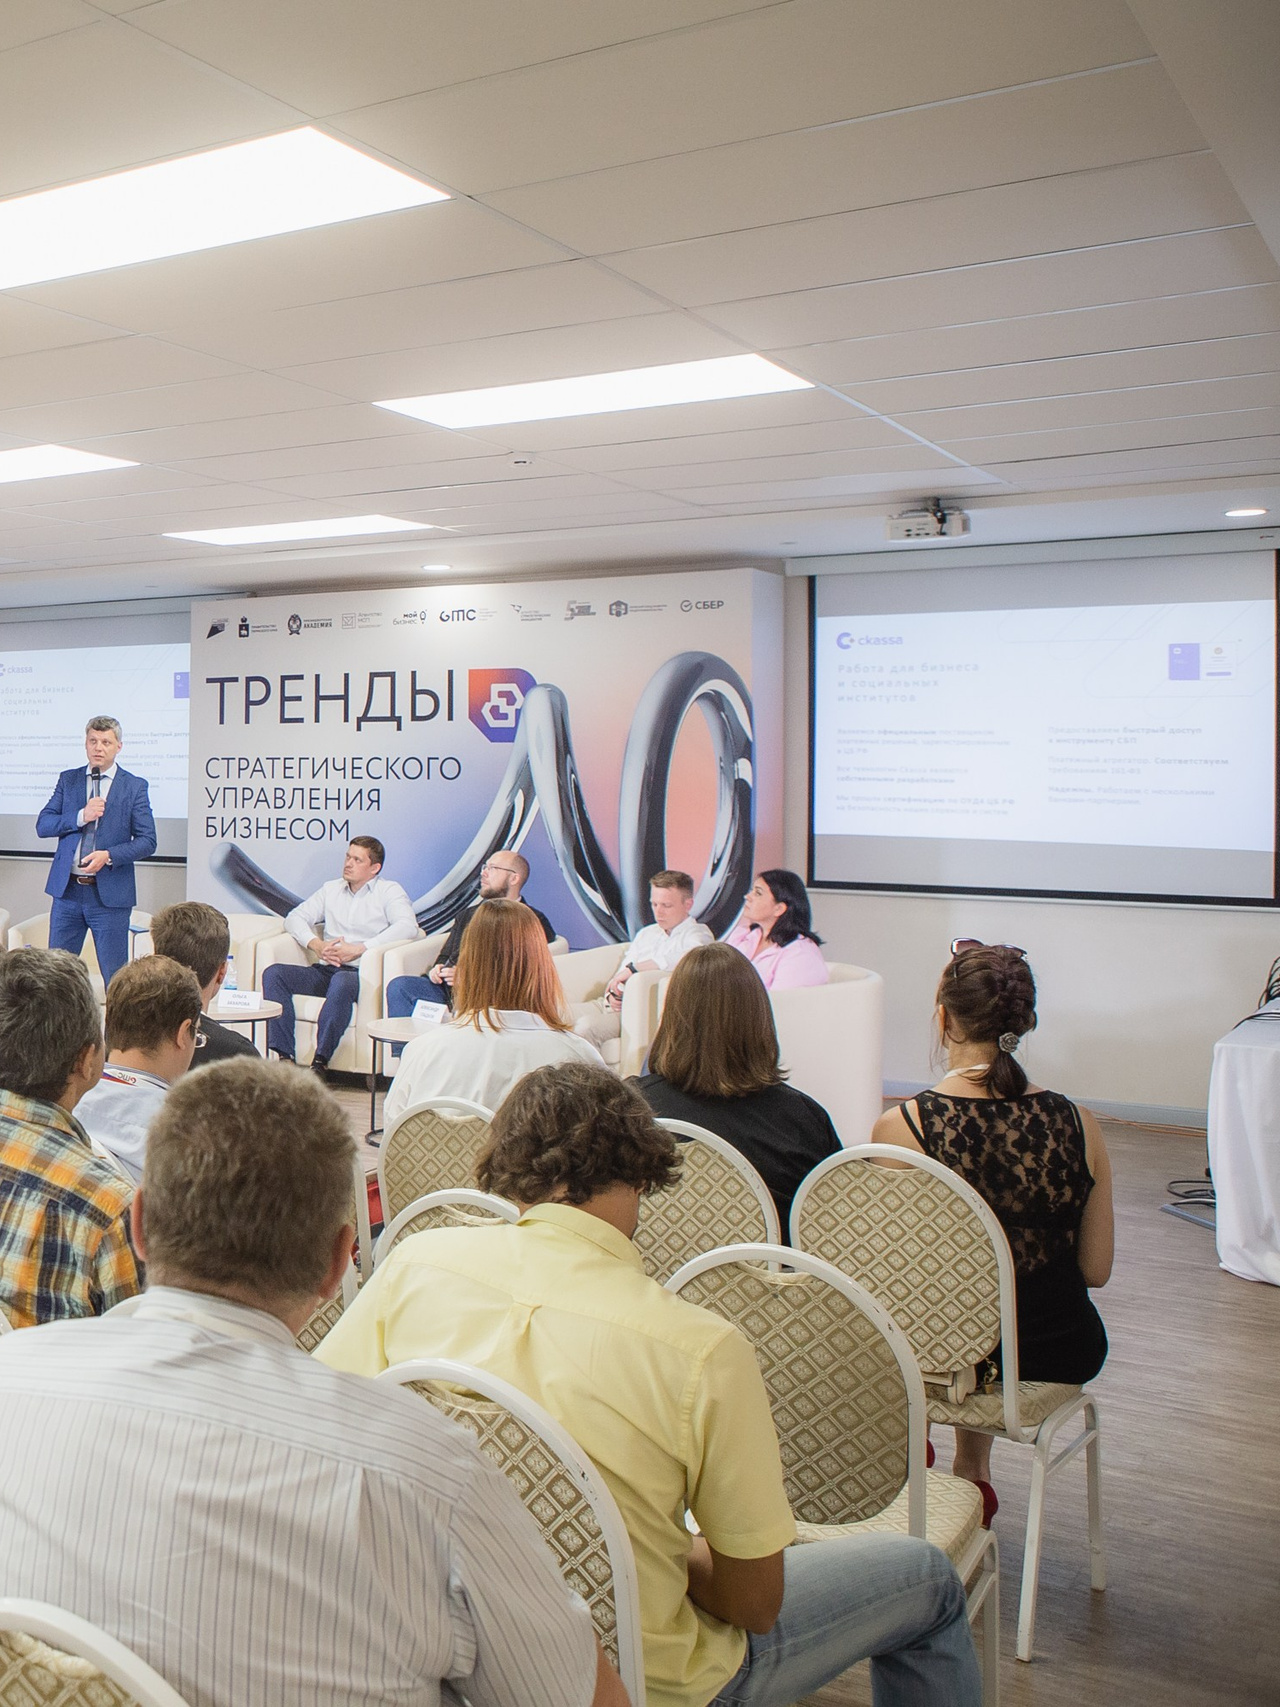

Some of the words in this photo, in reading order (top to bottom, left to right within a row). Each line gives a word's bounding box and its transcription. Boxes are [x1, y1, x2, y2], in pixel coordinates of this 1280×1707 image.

[695, 600, 724, 609] СБЕР
[858, 635, 903, 645] ckassa
[7, 665, 33, 674] ckassa
[838, 664, 884, 673] Работа
[890, 665, 914, 674] для
[921, 662, 979, 673] бизнеса
[42, 685, 74, 693] бизнеса
[852, 680, 939, 688] социальных
[206, 669, 454, 732] ТРЕНДЫ
[838, 695, 915, 703] институтов
[205, 757, 461, 780] СТРАТЕГИЧЕСКОГО
[205, 787, 380, 811] УПРАВЛЕНИЯ
[205, 817, 350, 841] БИЗНЕСОМ
